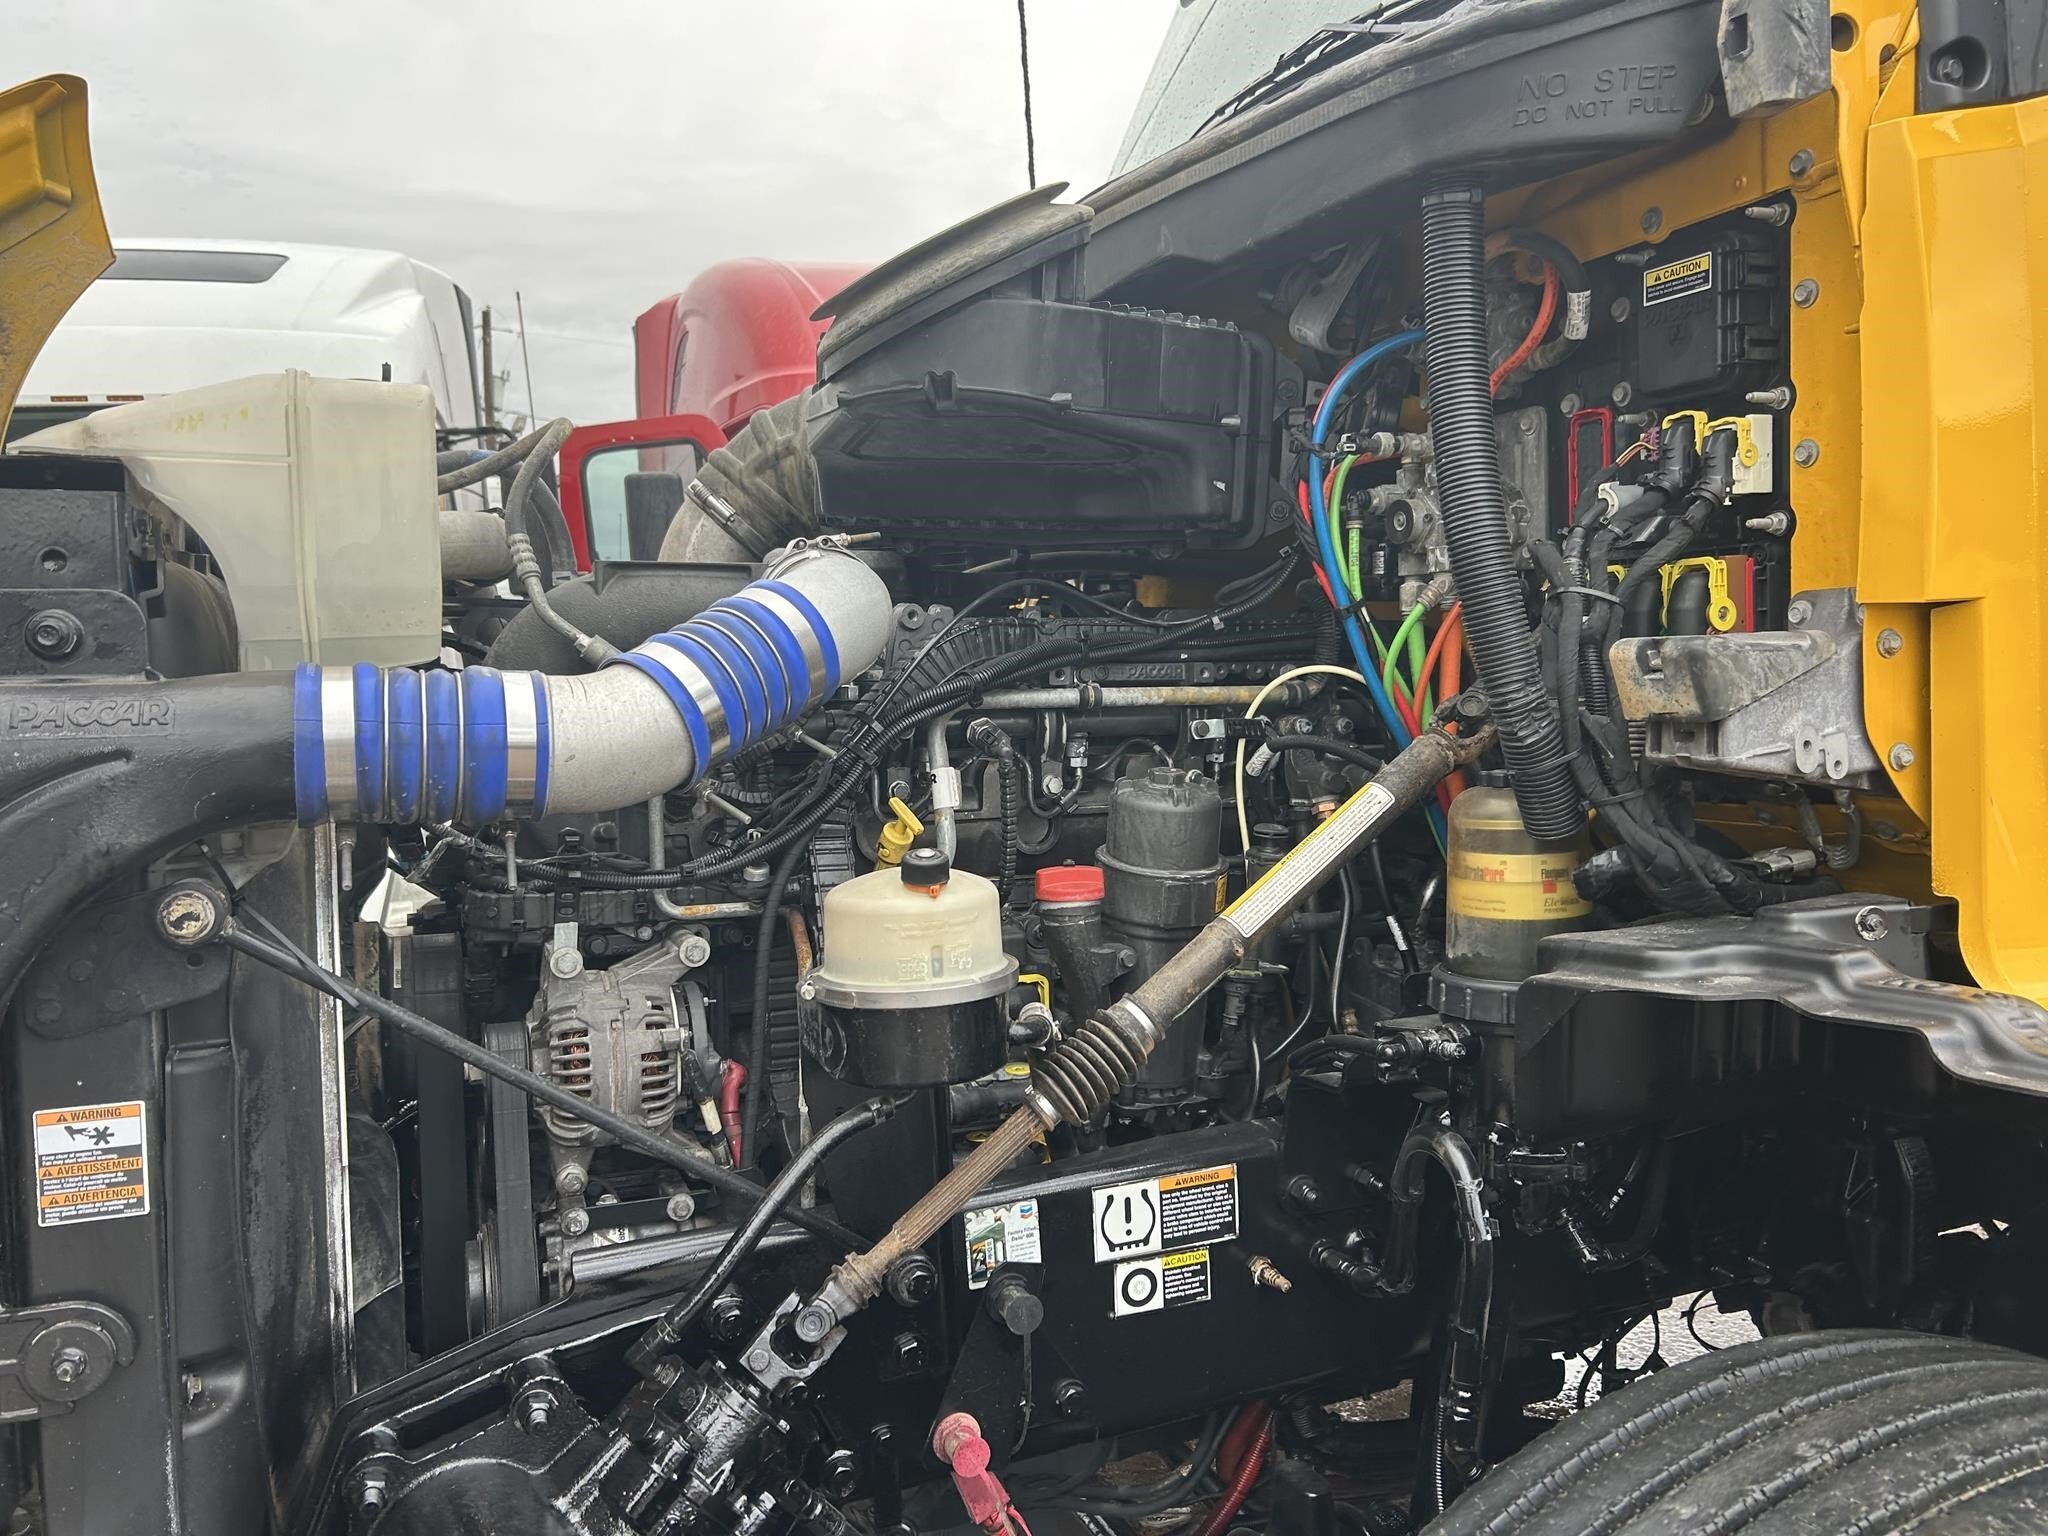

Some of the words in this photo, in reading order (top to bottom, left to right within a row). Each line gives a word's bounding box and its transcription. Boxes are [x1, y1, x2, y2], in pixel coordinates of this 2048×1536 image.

[1518, 72, 1567, 102] NO
[1594, 64, 1677, 93] STEP
[1512, 106, 1547, 128] DO
[1565, 100, 1614, 120] NOT
[1628, 97, 1683, 115] PULL
[1663, 261, 1701, 280] CAUTION
[1127, 664, 1184, 679] PACCAR
[9, 699, 170, 730] PACCAR
[70, 1108, 122, 1121] WARNING
[57, 1158, 140, 1176] AVERTISSEMENT
[1181, 1172, 1220, 1185] WARNING
[63, 1187, 137, 1204] ADVERTENCIA
[1170, 1253, 1206, 1265] CAUTION
